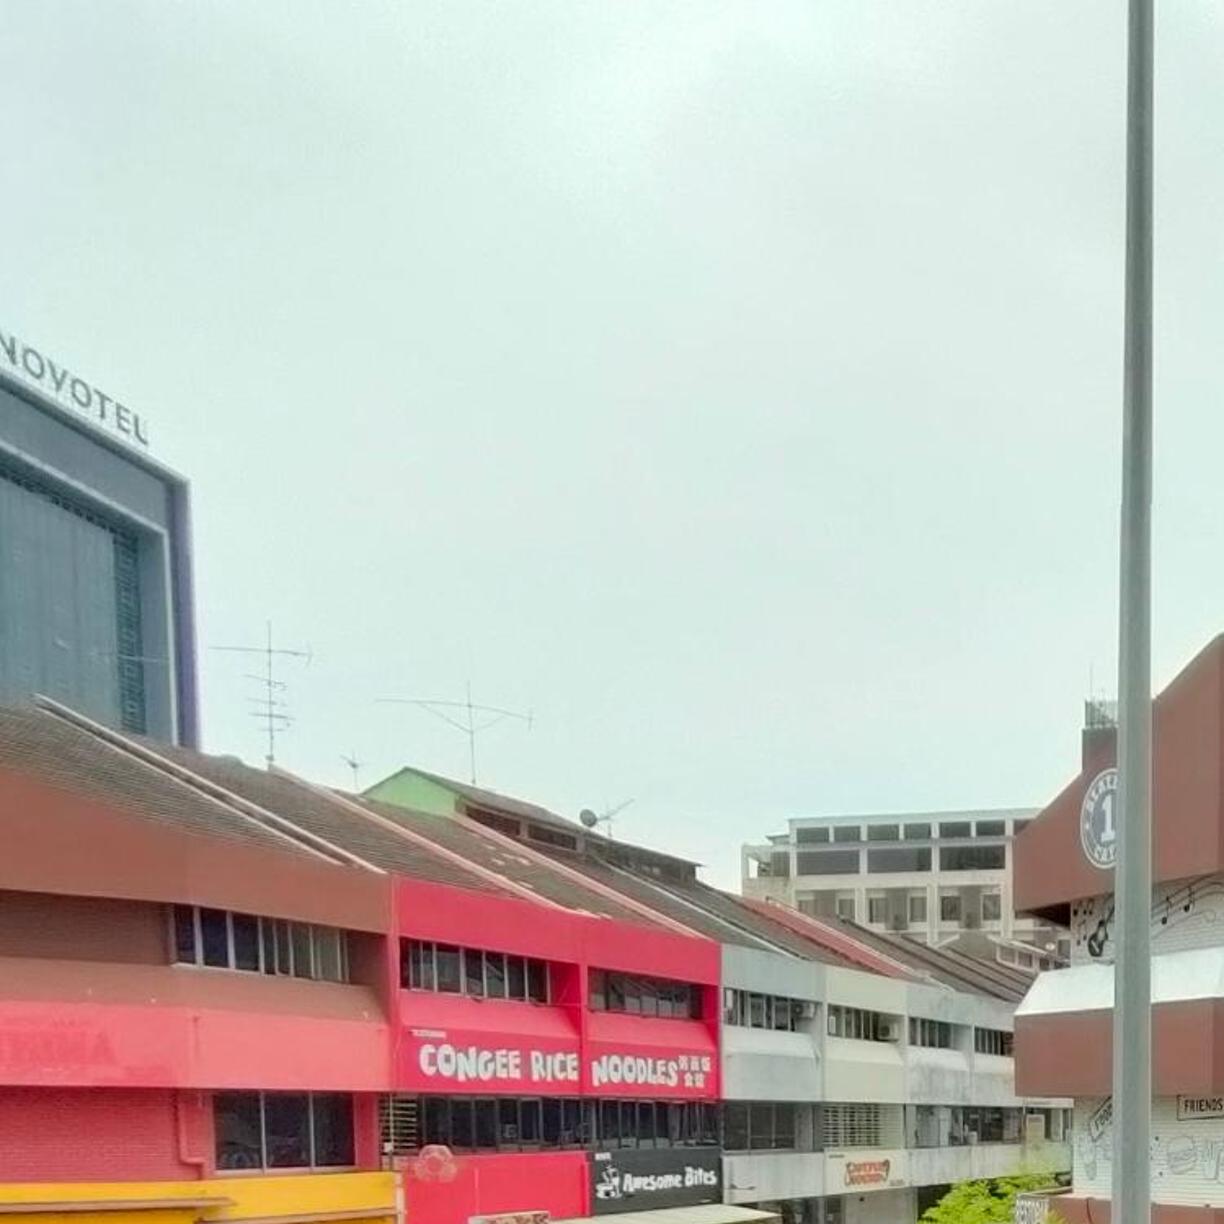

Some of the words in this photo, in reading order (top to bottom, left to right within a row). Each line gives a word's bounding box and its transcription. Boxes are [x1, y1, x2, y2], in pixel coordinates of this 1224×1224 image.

[0, 334, 148, 445] NOVOTEL
[419, 1043, 521, 1082] CONGEE
[530, 1050, 579, 1082] RICE
[591, 1054, 678, 1088] NOODLES
[1184, 1098, 1223, 1113] FRIENDS
[622, 1172, 683, 1193] Awesome
[684, 1166, 717, 1187] Bites
